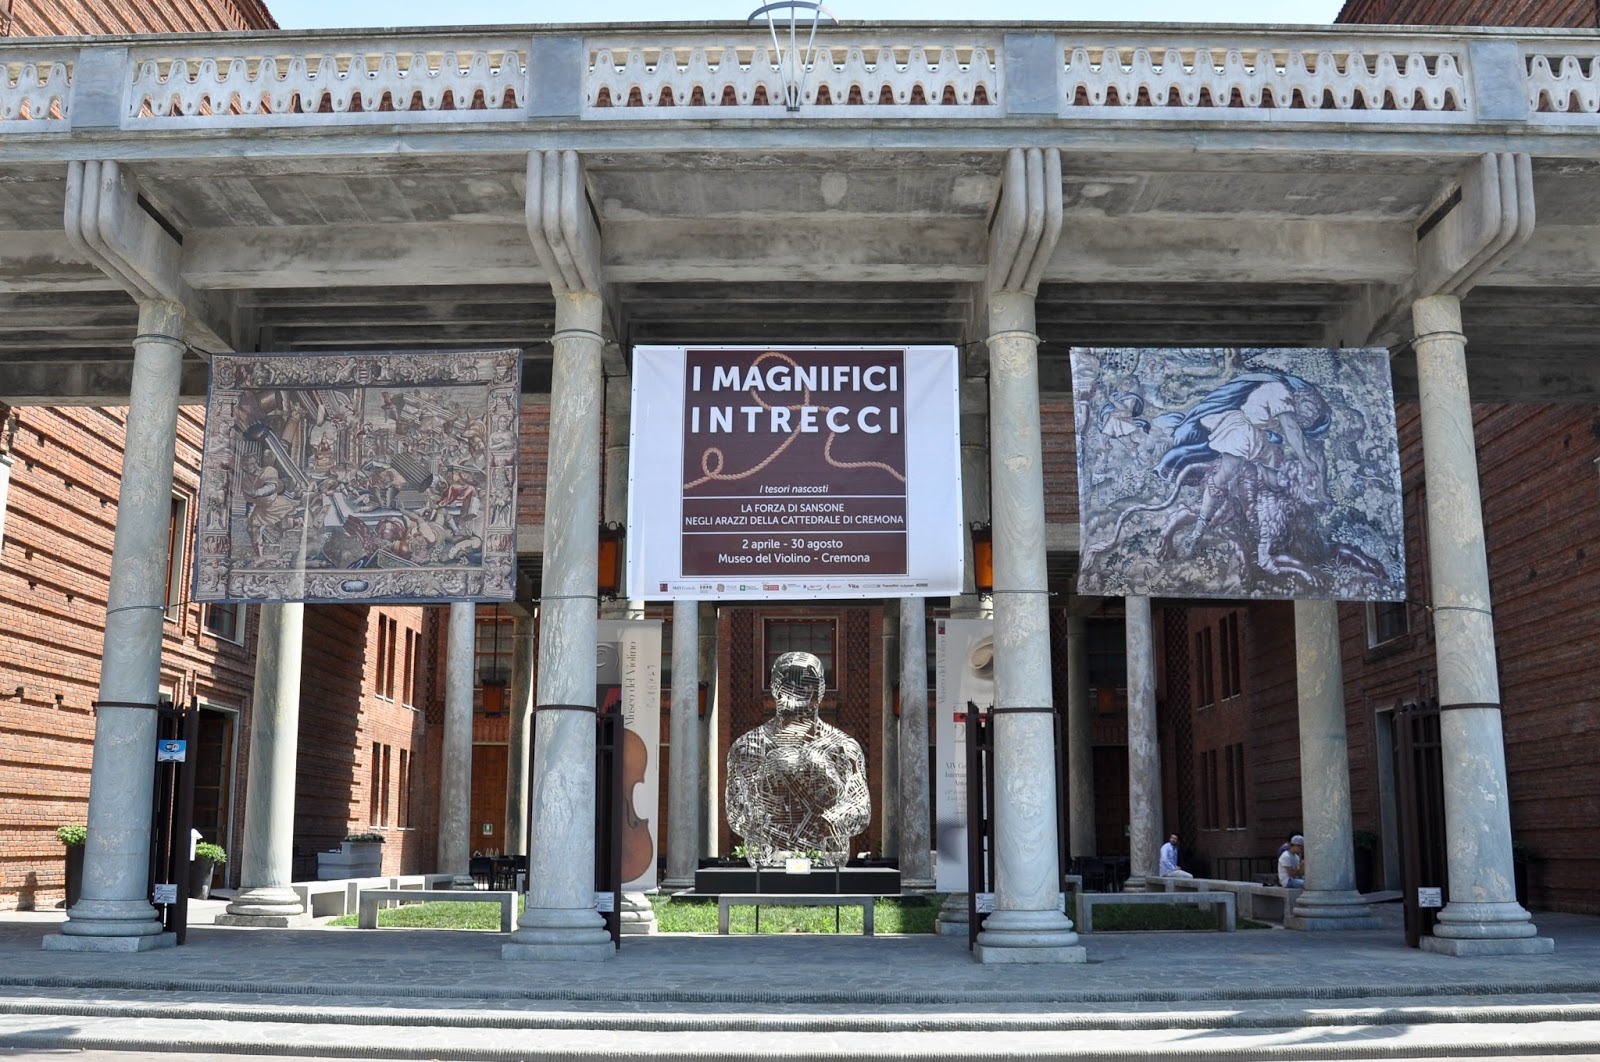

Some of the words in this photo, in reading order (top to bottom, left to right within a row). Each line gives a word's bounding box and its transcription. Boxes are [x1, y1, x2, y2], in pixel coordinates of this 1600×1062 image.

[693, 366, 701, 391] I
[712, 366, 898, 391] MAGNIFICI
[691, 406, 898, 433] INTRECCI
[759, 485, 763, 493] I
[765, 485, 790, 493] tesori
[792, 484, 829, 493] nascosti
[741, 504, 753, 512] LA
[755, 504, 785, 512] FORZA
[788, 504, 798, 512] DI
[800, 503, 845, 512] SANSONE
[685, 516, 713, 525] NEGLI
[715, 516, 748, 525] ARAZZI
[750, 515, 779, 524] DELLA
[781, 515, 840, 524] CATTEDRALE
[843, 515, 853, 524] DI
[855, 515, 904, 524] CREMONA
[742, 539, 749, 549] 2
[751, 539, 780, 551] aprile
[791, 538, 805, 549] 30
[807, 539, 843, 551] agosto
[718, 554, 753, 563] Museo
[755, 553, 772, 563] del
[774, 553, 811, 563] Violino
[821, 552, 870, 563] Cremona
[626, 641, 637, 675] Violino
[626, 678, 636, 692] del
[625, 695, 635, 727] Museo
